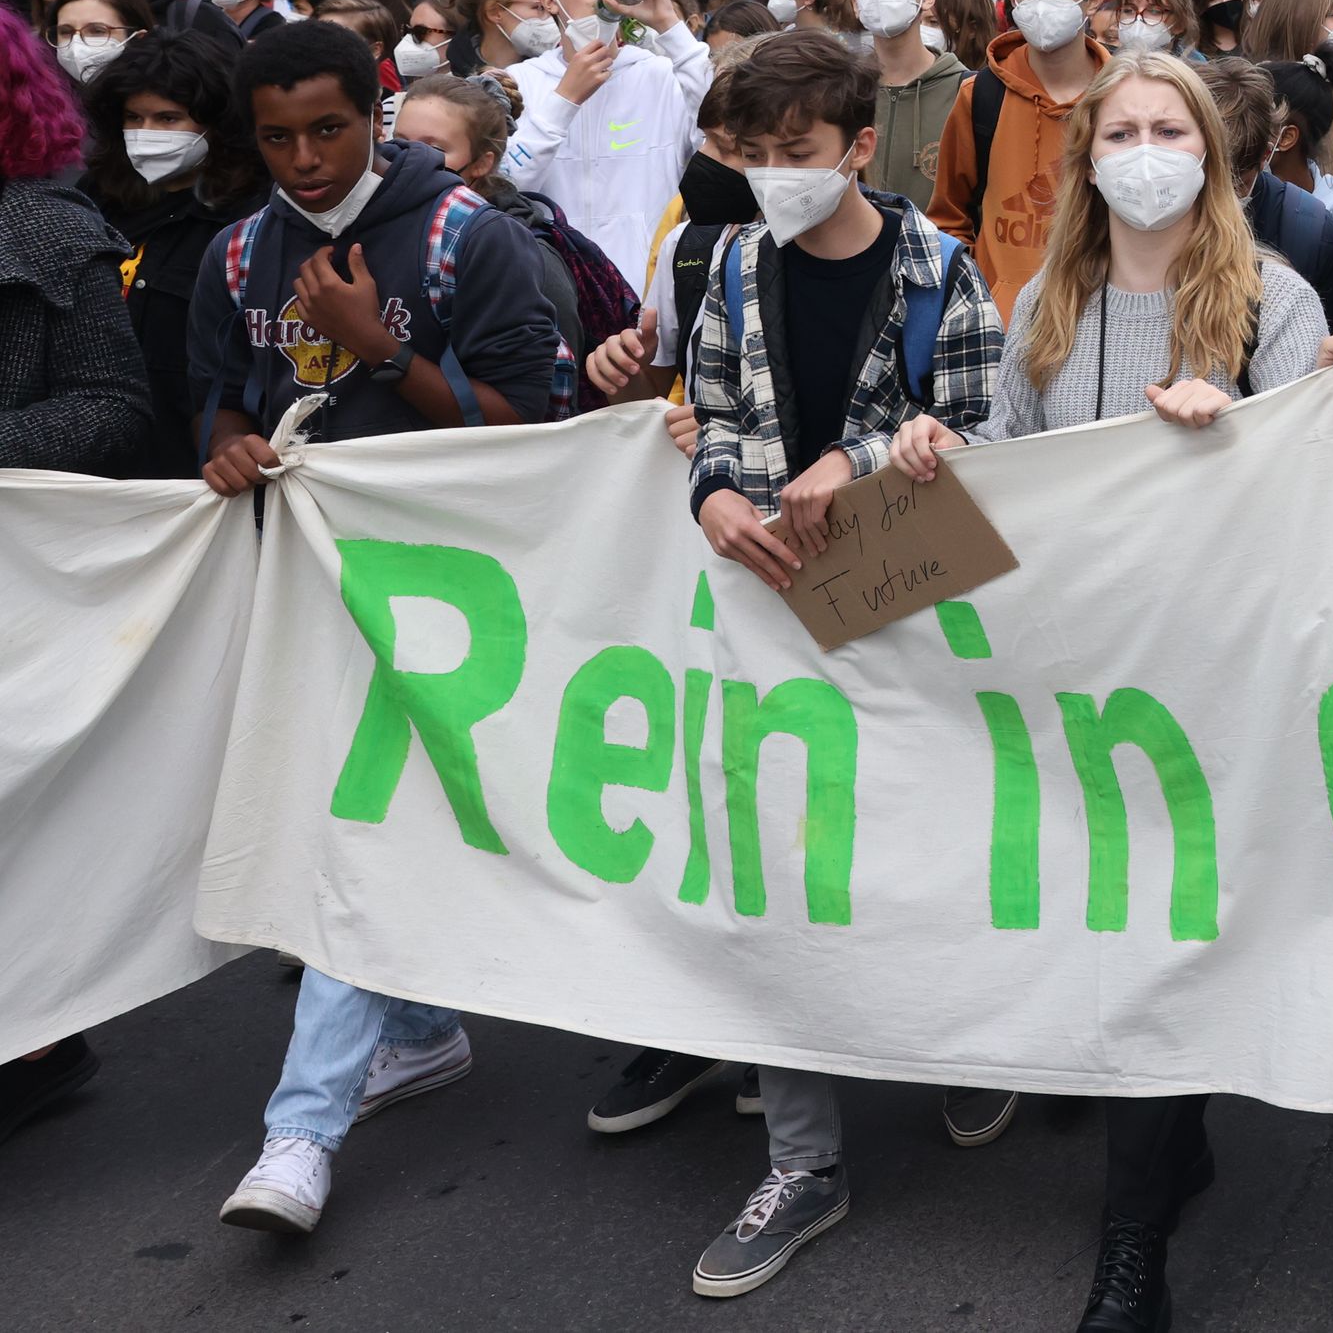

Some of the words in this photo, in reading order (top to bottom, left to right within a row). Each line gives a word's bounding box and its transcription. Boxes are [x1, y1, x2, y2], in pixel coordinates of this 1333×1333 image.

[995, 213, 1048, 249] adi
[811, 559, 949, 626] Future
[328, 538, 859, 926] Rein
[935, 601, 1220, 942] in
